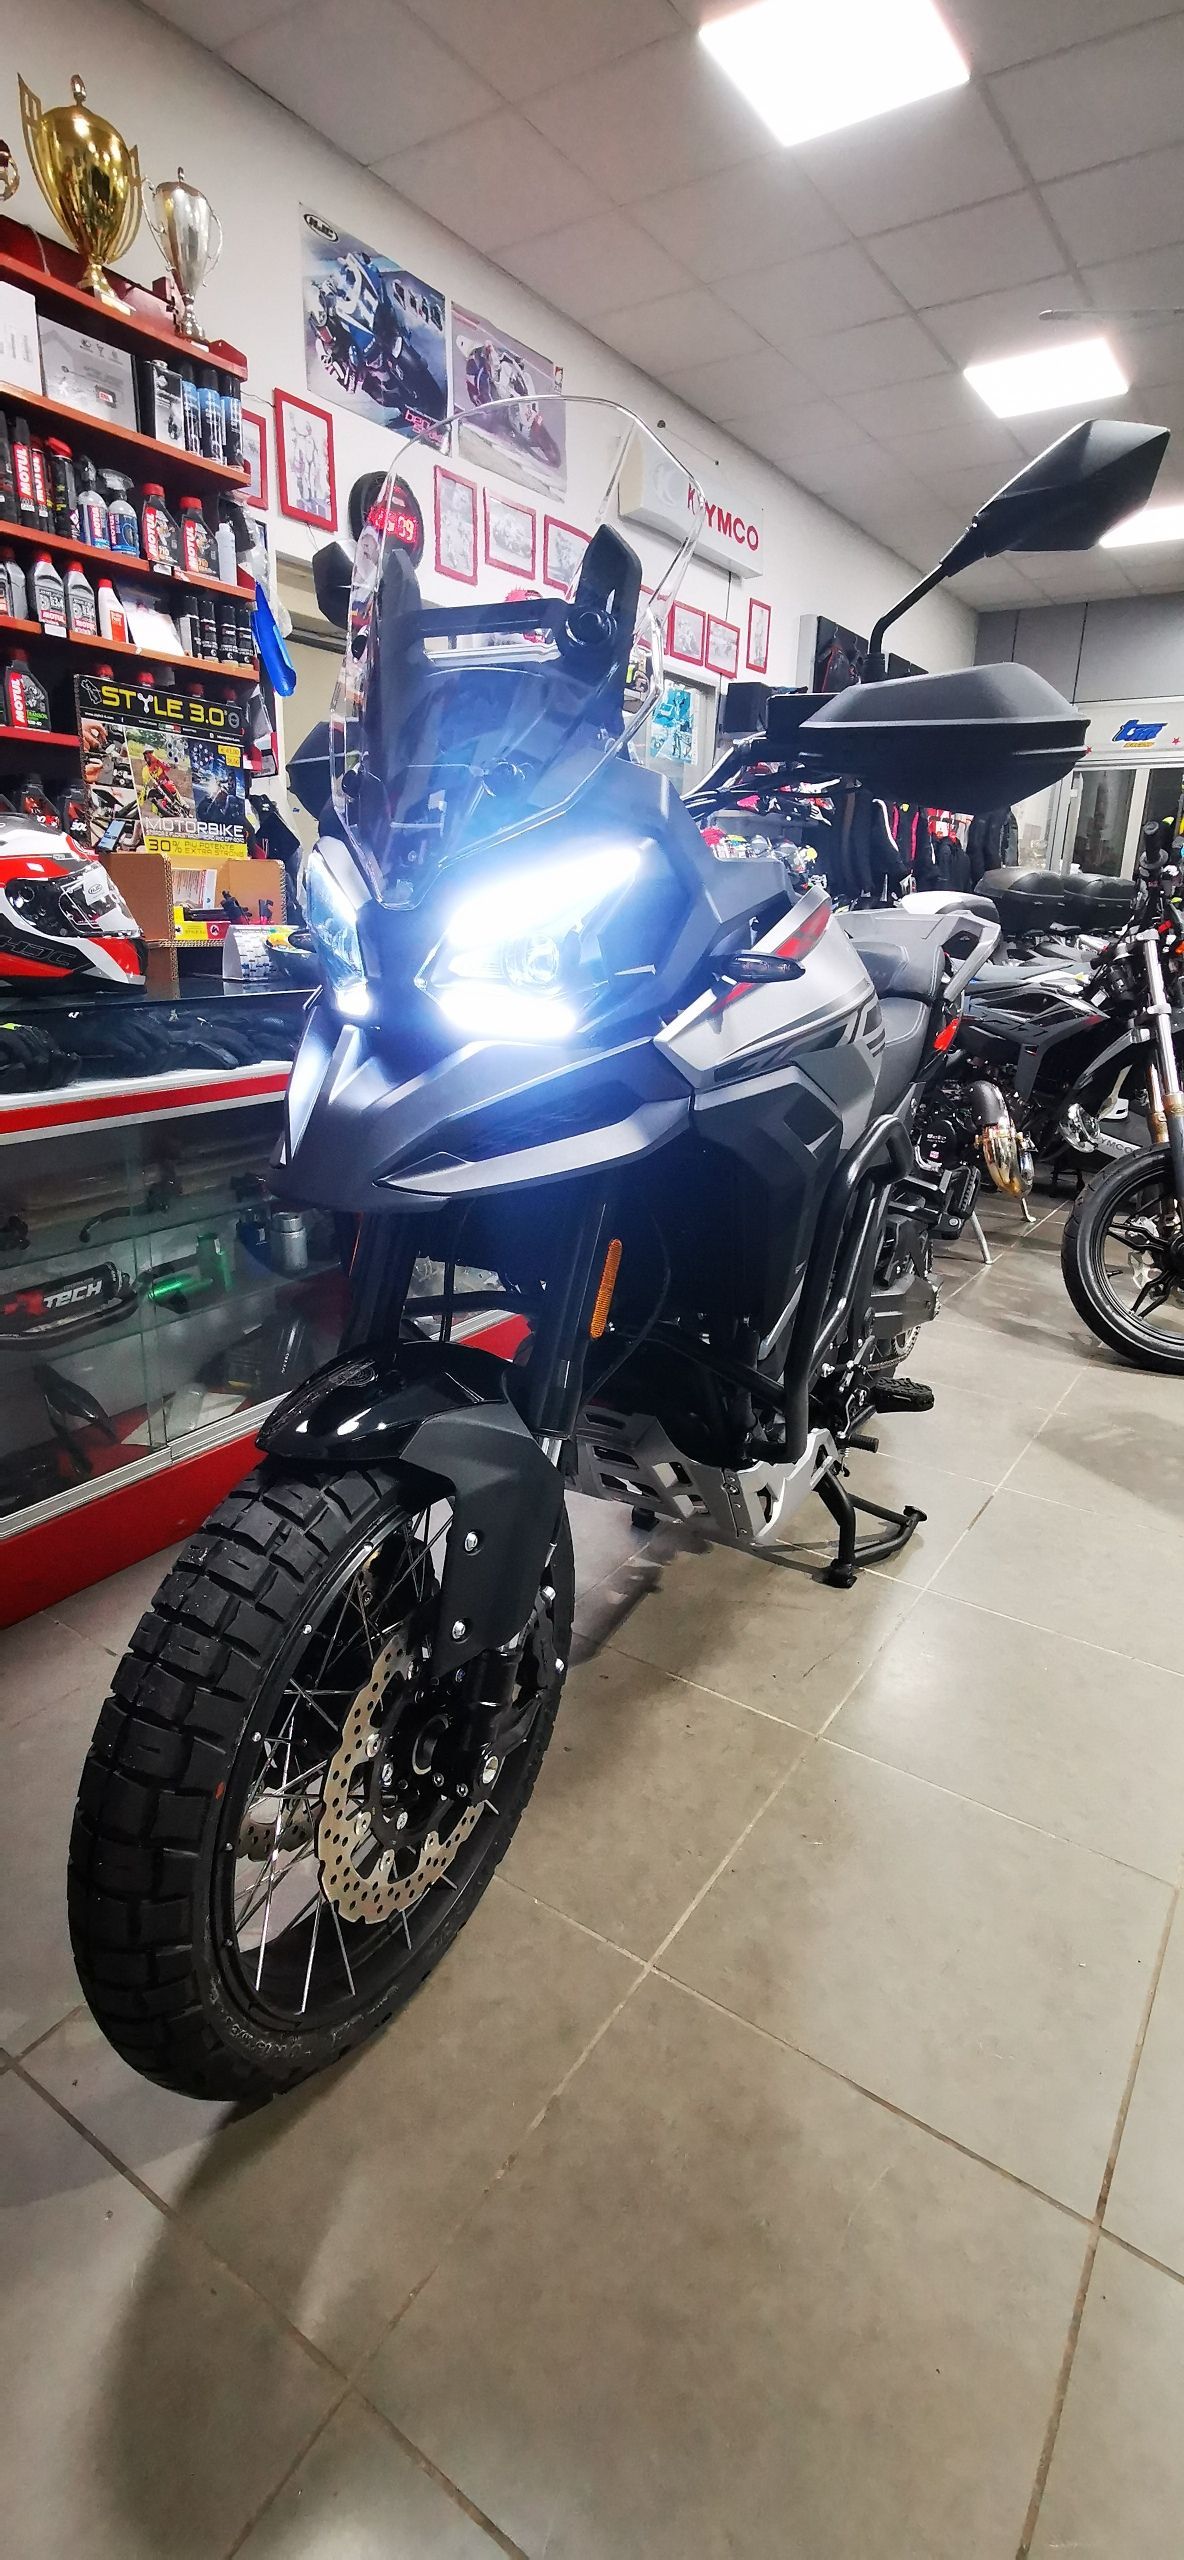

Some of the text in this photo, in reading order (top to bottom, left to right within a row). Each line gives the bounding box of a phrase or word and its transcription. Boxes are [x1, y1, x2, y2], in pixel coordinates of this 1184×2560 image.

[17, 448, 32, 497] MOTUL
[146, 513, 159, 557] MOTUL
[186, 526, 199, 572] MOTUL
[11, 679, 25, 723] MOTUL
[101, 685, 225, 727] STYLE 3.0
[145, 818, 244, 838] MOTORBIKE
[199, 842, 235, 851] POTENTE
[184, 847, 213, 855] EXTRA
